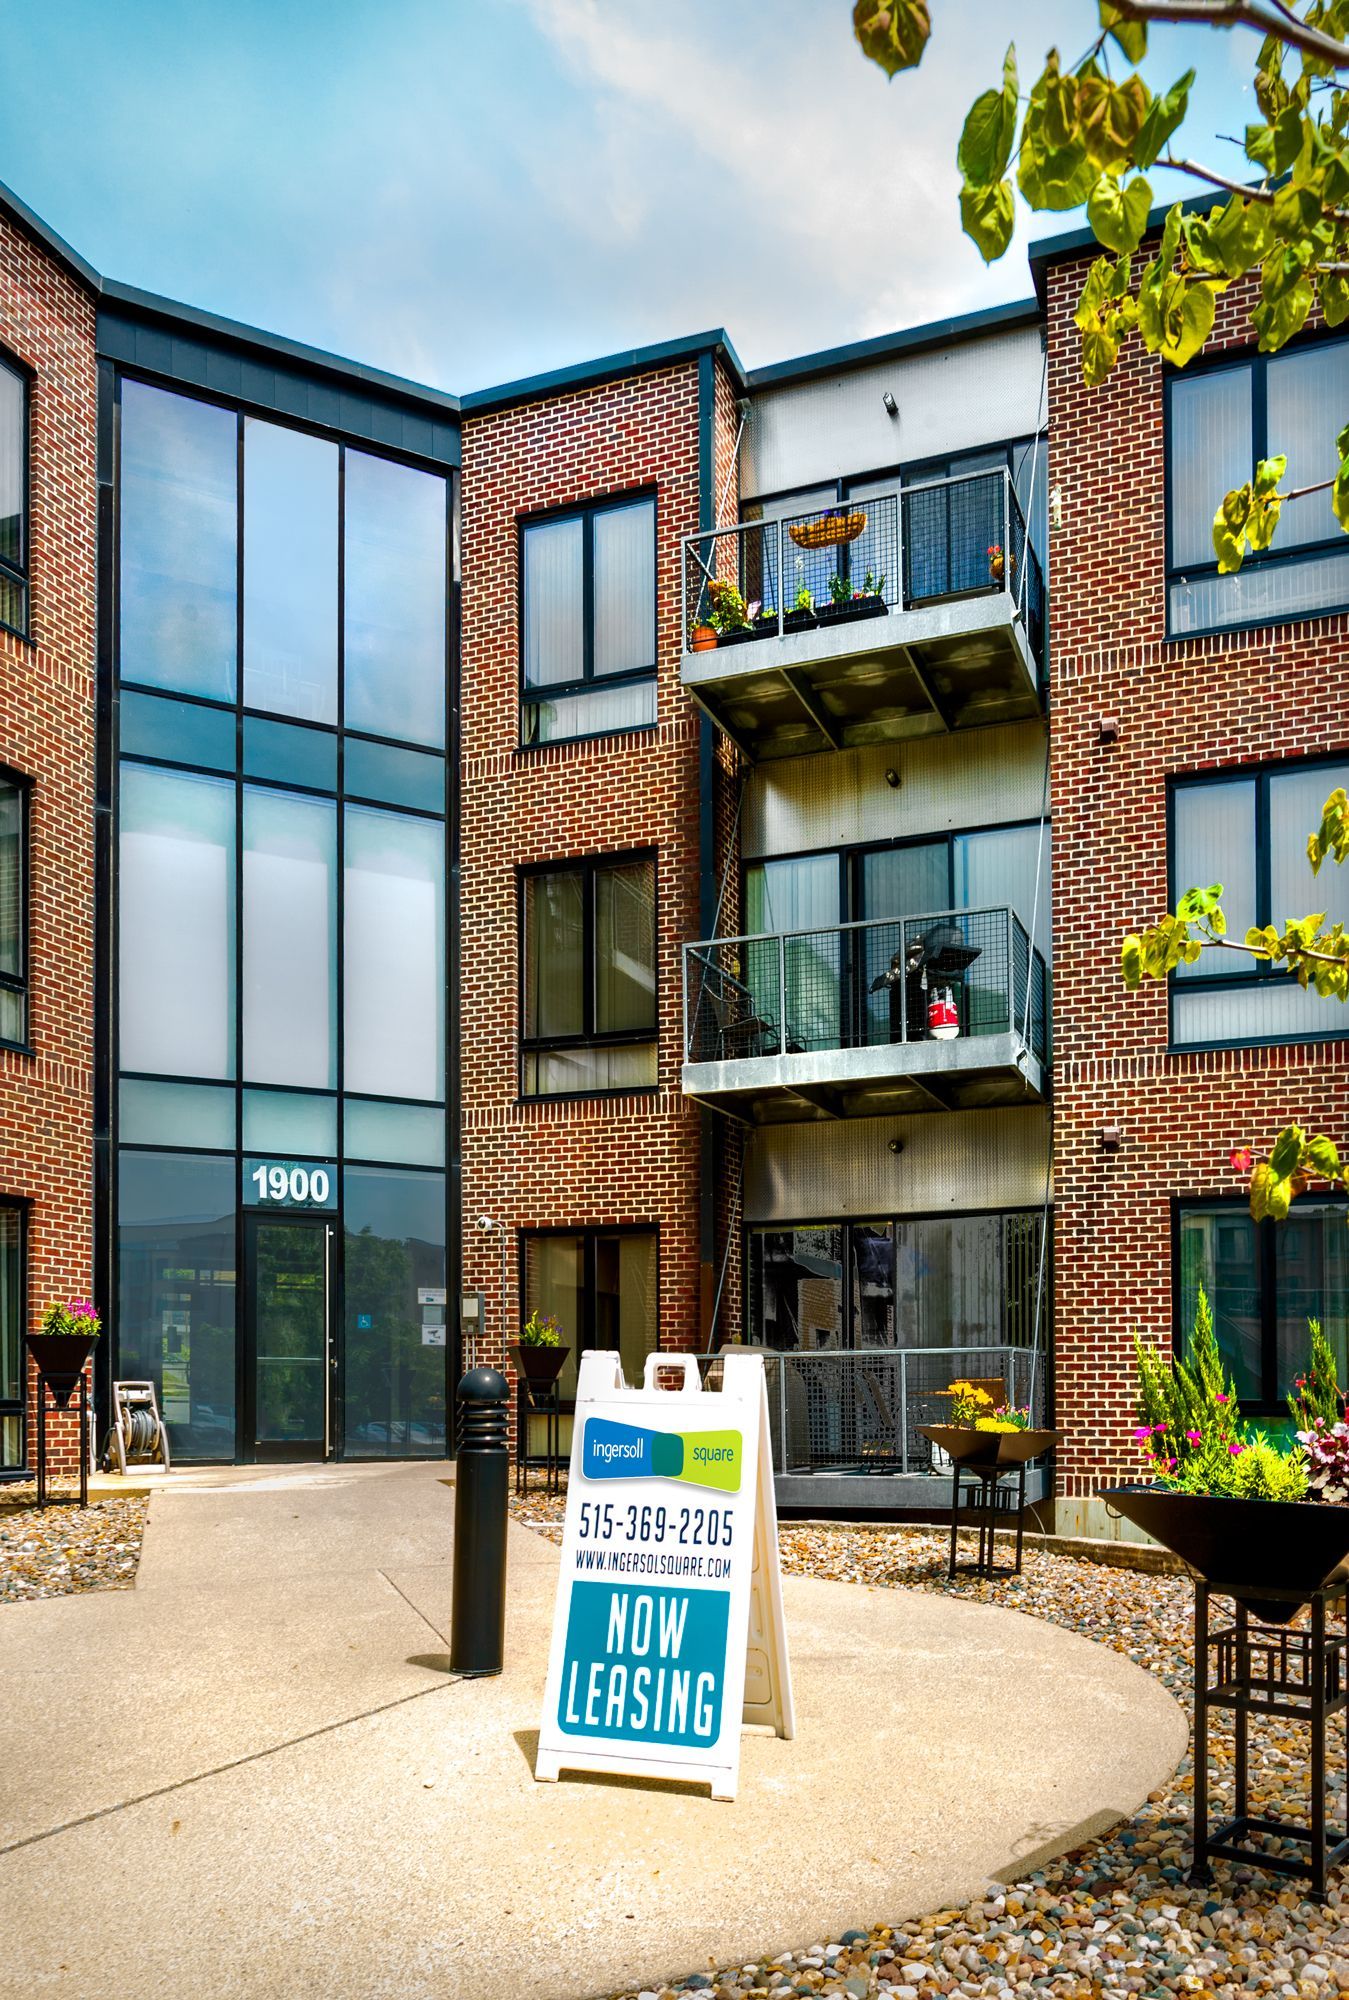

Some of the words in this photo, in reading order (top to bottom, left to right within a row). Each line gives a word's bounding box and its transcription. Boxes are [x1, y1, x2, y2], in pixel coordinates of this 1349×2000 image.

[252, 1165, 329, 1203] 1900
[593, 1438, 644, 1463] ingersoll
[692, 1447, 734, 1466] square
[579, 1502, 734, 1547] 515-369-2205
[576, 1549, 731, 1579] WWW.INGERSOLSQUARE.COM
[605, 1592, 690, 1660] NOW
[565, 1660, 716, 1737] LEASING
